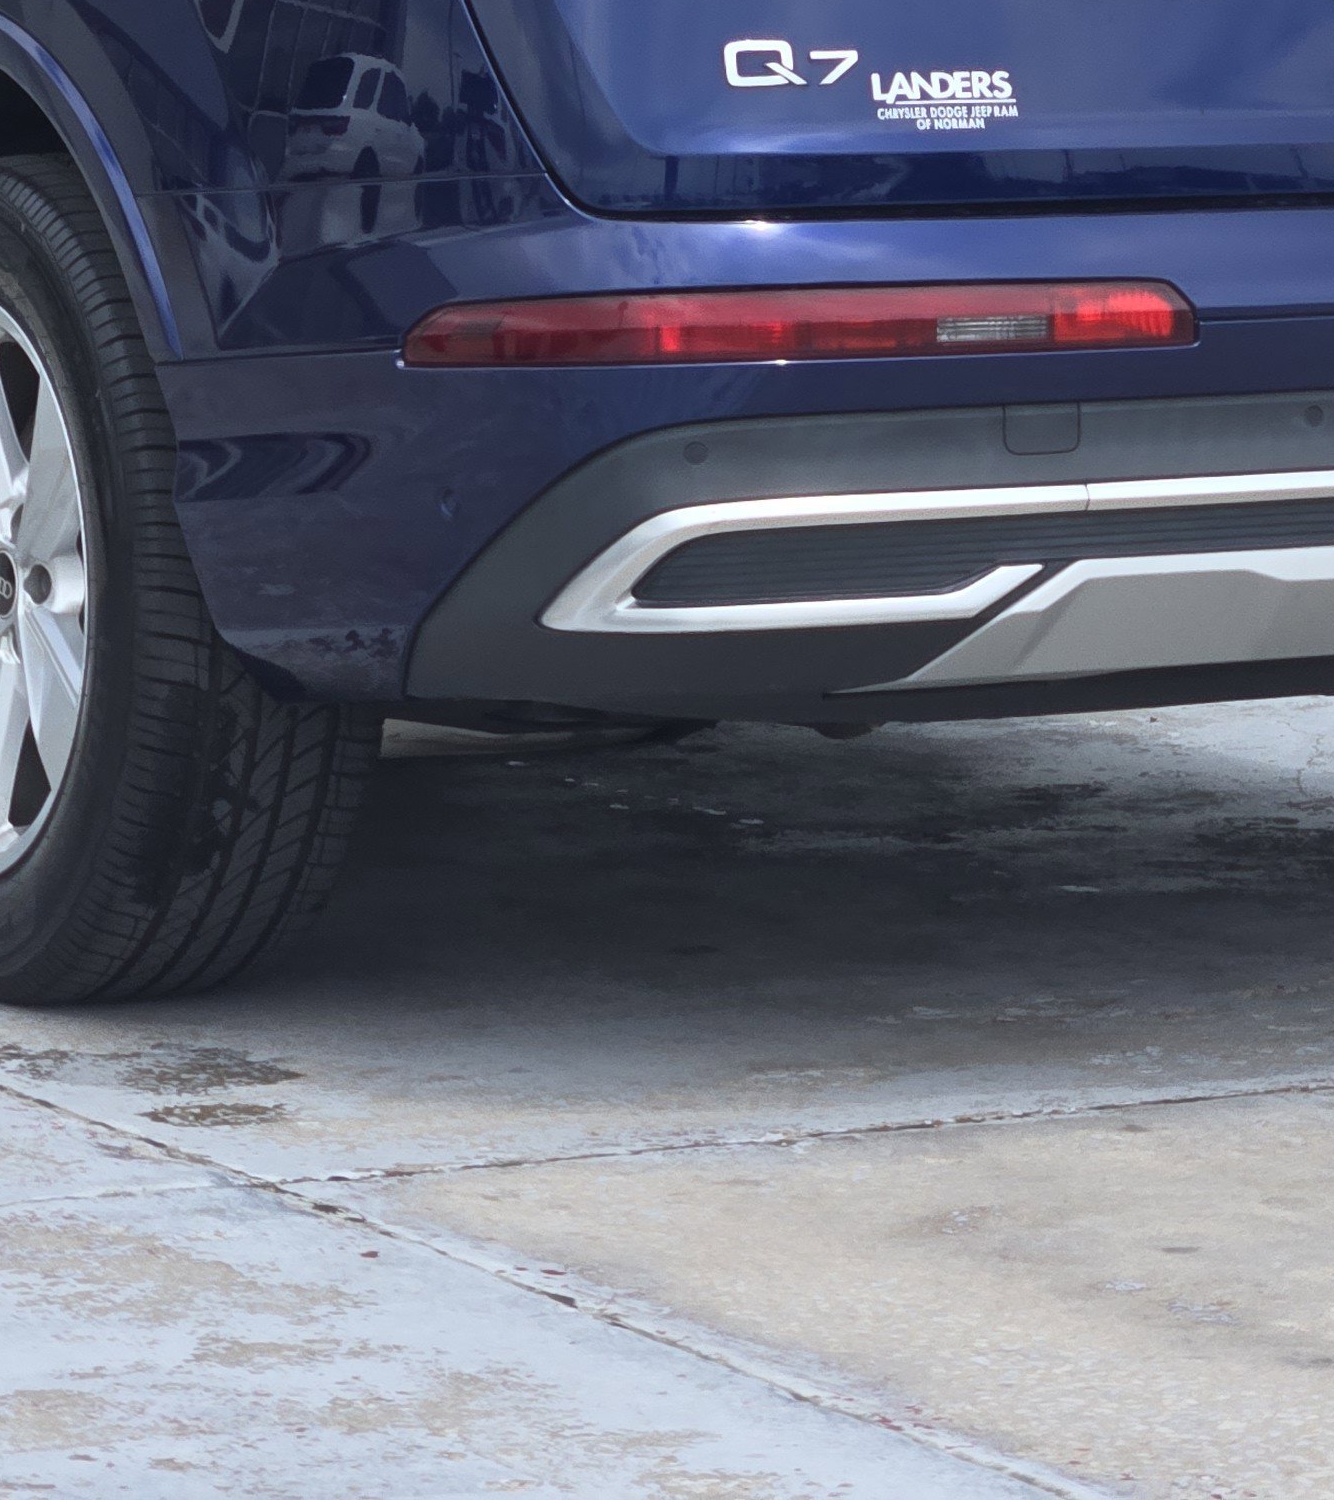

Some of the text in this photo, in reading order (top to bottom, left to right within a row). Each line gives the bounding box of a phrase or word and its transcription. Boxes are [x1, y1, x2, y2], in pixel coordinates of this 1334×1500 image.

[723, 39, 859, 87] Q7
[870, 70, 1013, 105] LANDERS
[876, 104, 1019, 120] CHRYSLER DODGE JEEP RAM
[916, 118, 986, 130] OF NORMAN
